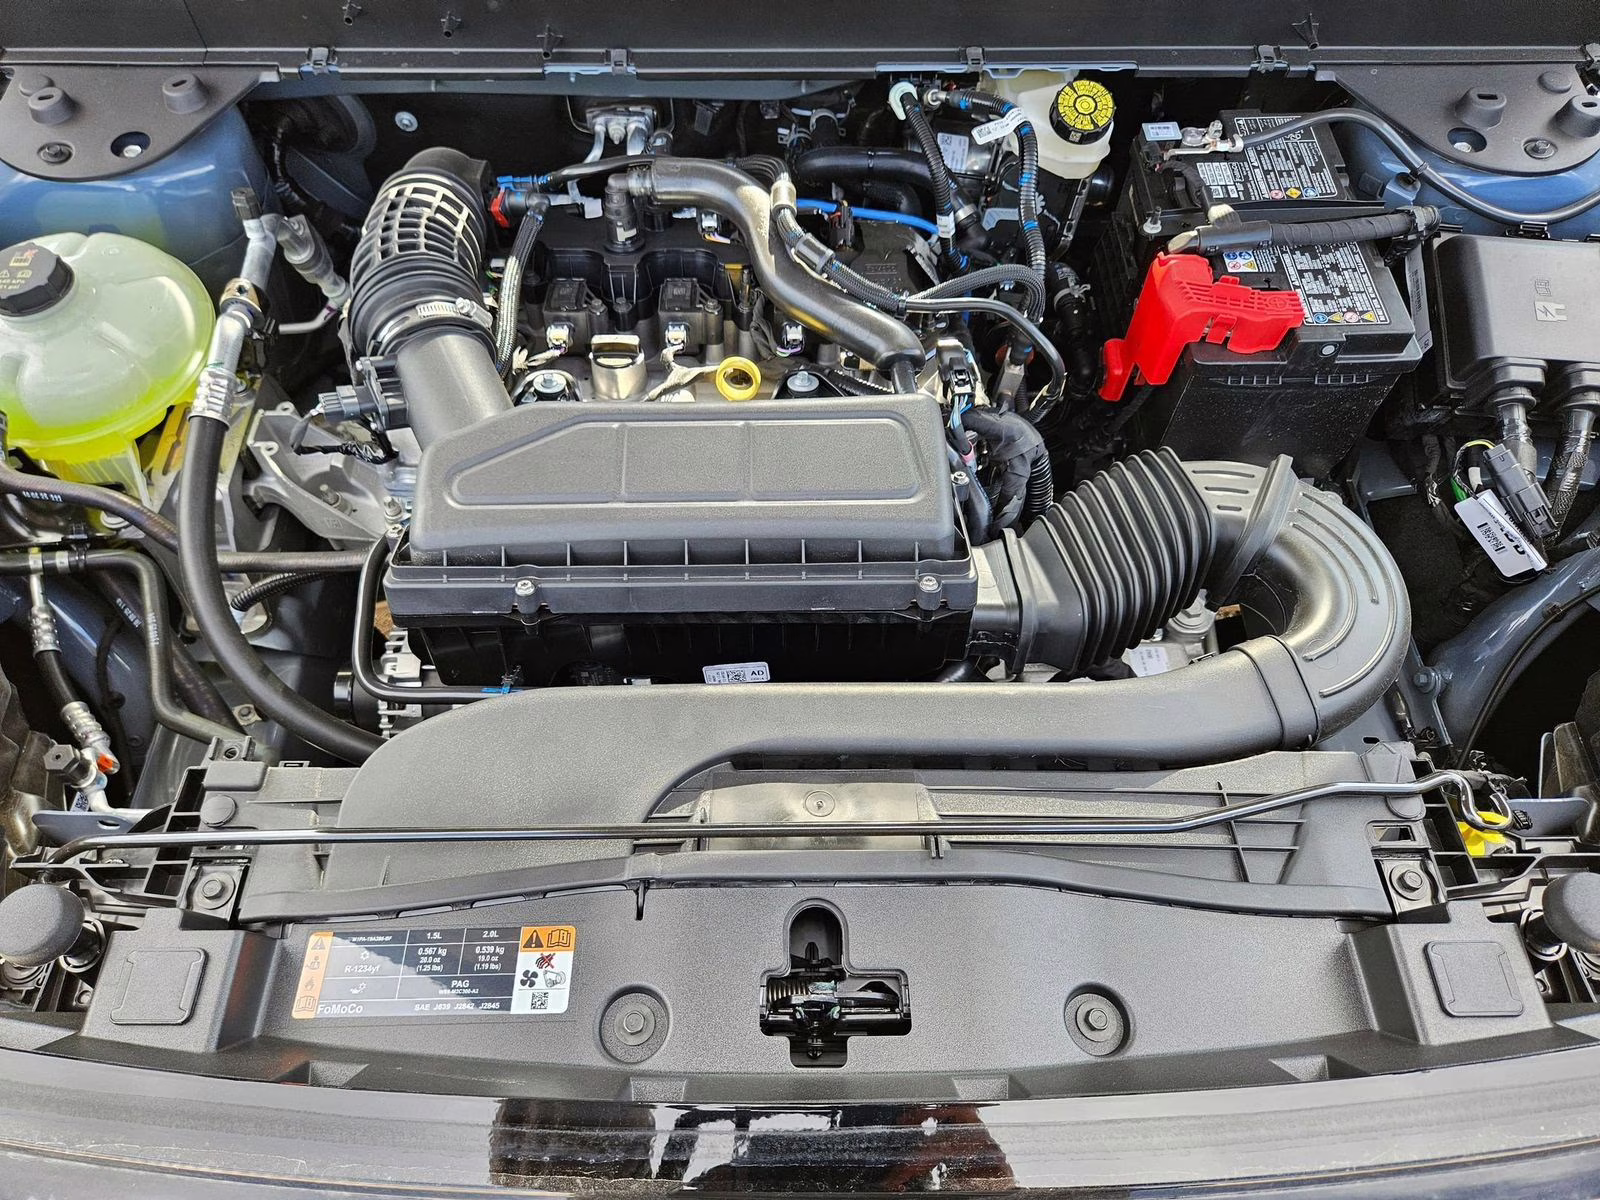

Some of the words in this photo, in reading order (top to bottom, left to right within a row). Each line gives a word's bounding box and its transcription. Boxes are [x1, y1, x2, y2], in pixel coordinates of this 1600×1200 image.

[426, 932, 442, 940] 1.5L
[482, 930, 499, 938] 2.0L
[418, 947, 436, 955] 0.567
[438, 947, 447, 956] kg
[476, 946, 494, 954] 0.539
[495, 946, 505, 954] kg
[344, 964, 381, 974] R-1234yf
[432, 964, 444, 972] lbs)
[474, 963, 489, 971] (1.19
[490, 963, 502, 971] lbs)
[451, 980, 470, 988] PAG
[316, 1003, 363, 1014] FoMoCo
[414, 1003, 431, 1011] SAE
